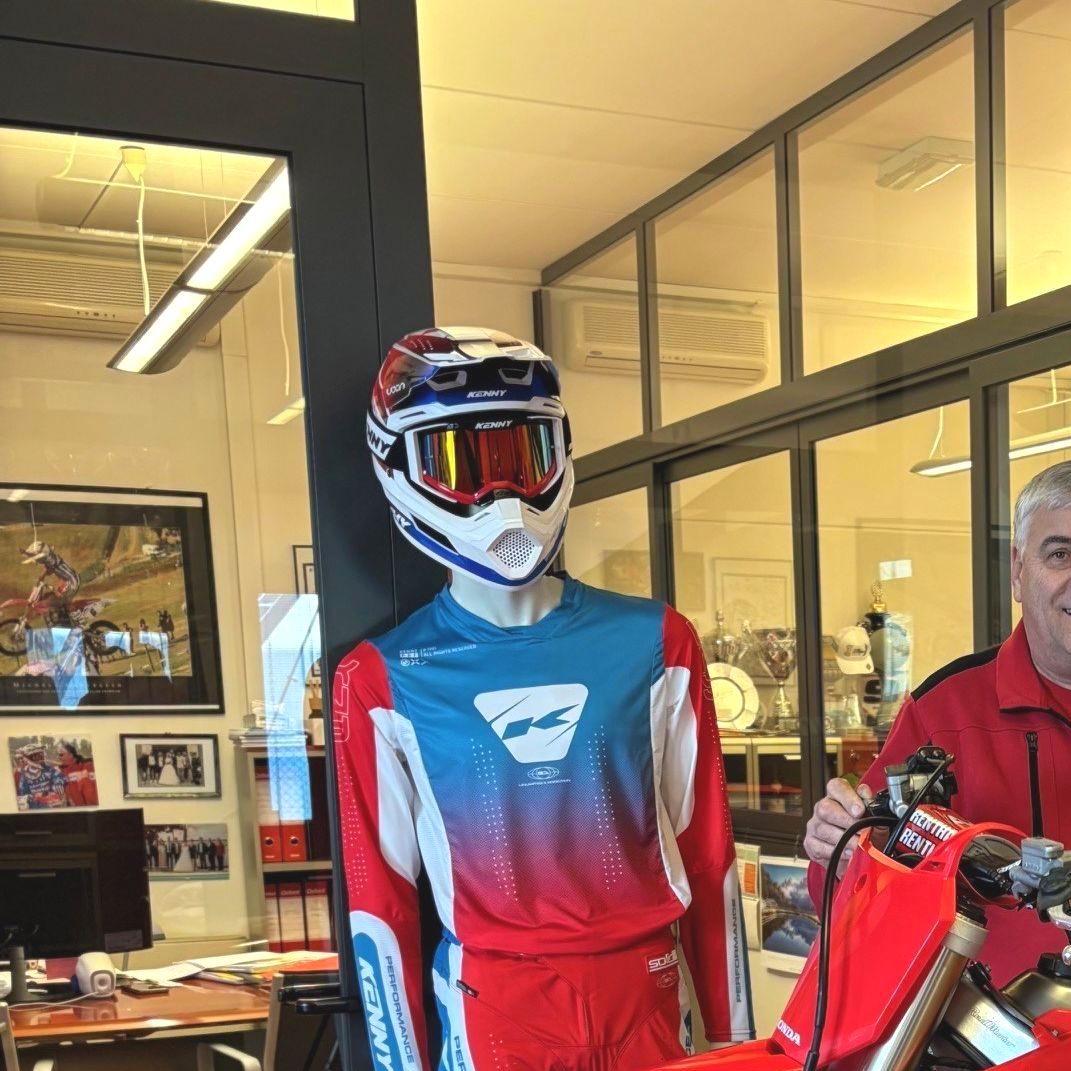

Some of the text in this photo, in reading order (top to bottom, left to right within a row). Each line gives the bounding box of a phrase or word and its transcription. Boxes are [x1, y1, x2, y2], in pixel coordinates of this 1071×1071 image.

[467, 390, 507, 398] KENNY
[475, 420, 513, 430] KENNY
[899, 828, 936, 856] RENT
[731, 899, 742, 1003] PERFORMANCE
[385, 955, 414, 1064] PERFORMANCE
[777, 1019, 801, 1046] ONDA
